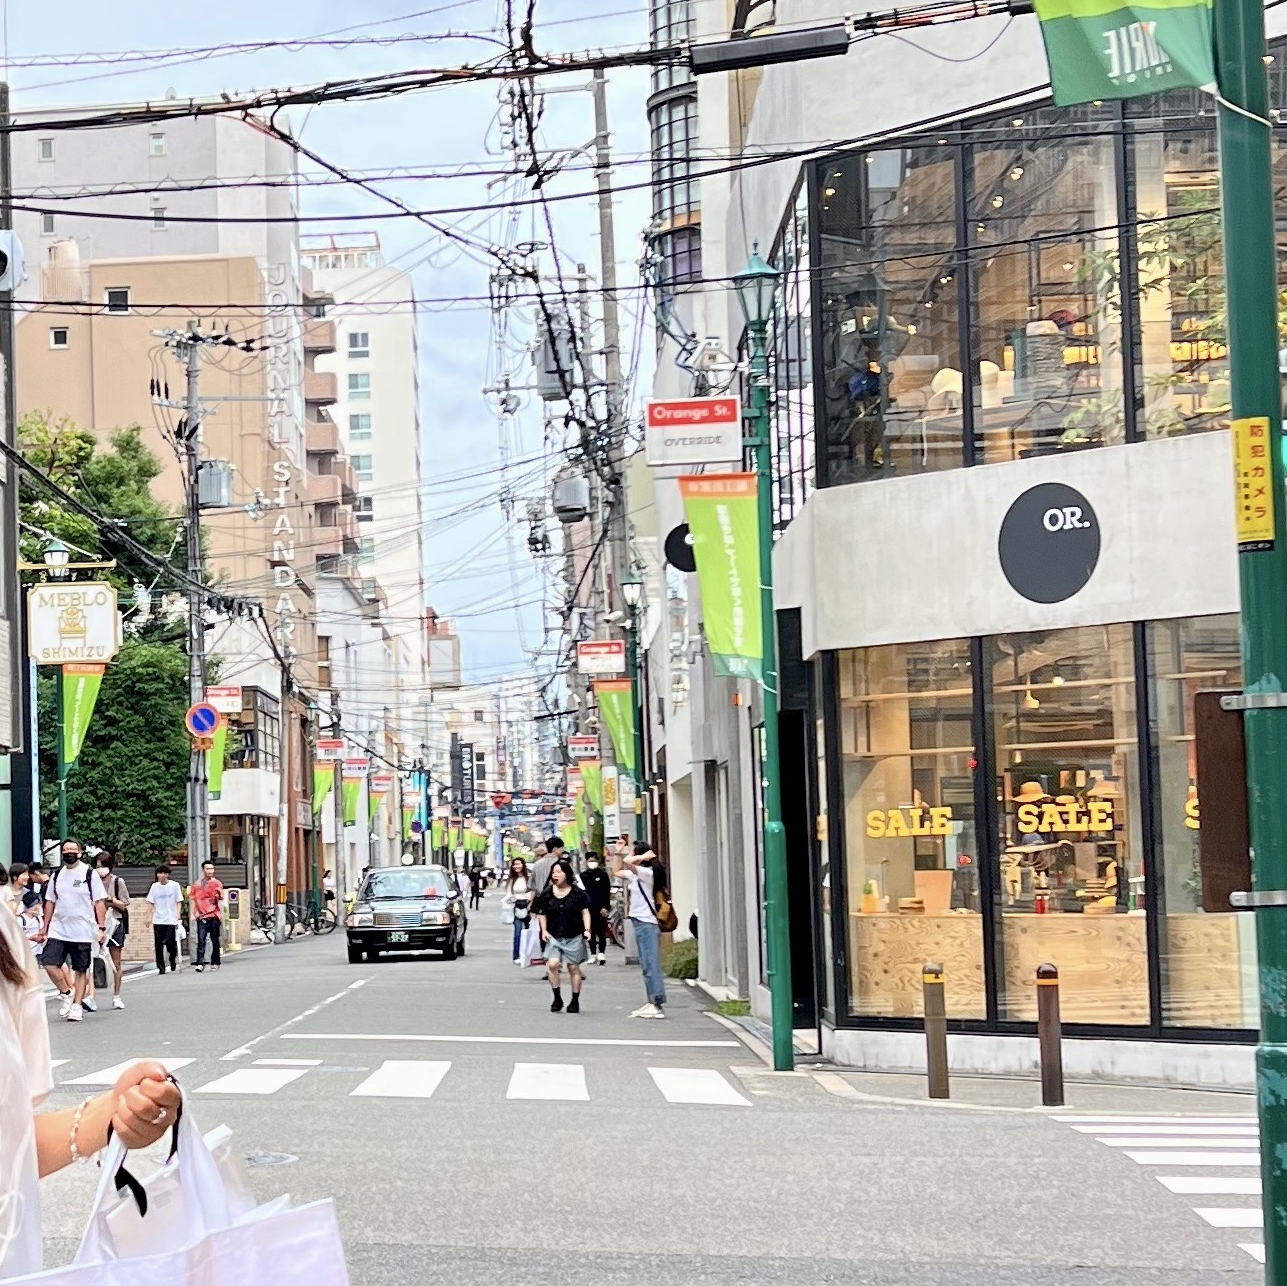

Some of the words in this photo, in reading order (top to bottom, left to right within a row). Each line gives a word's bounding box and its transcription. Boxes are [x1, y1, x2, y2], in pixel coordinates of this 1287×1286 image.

[268, 263, 292, 443] JOURNAL
[652, 405, 710, 421] Orange
[712, 403, 733, 417] St.
[664, 435, 723, 447] OVERRIDE
[1249, 424, 1267, 519] 防犯カメラ
[1043, 506, 1091, 532] OR.
[272, 461, 297, 664] STANDARD
[38, 591, 107, 607] MEBLO
[41, 646, 105, 659] SHIMIZU
[866, 806, 953, 838] SALE
[1017, 801, 1114, 833] SALE
